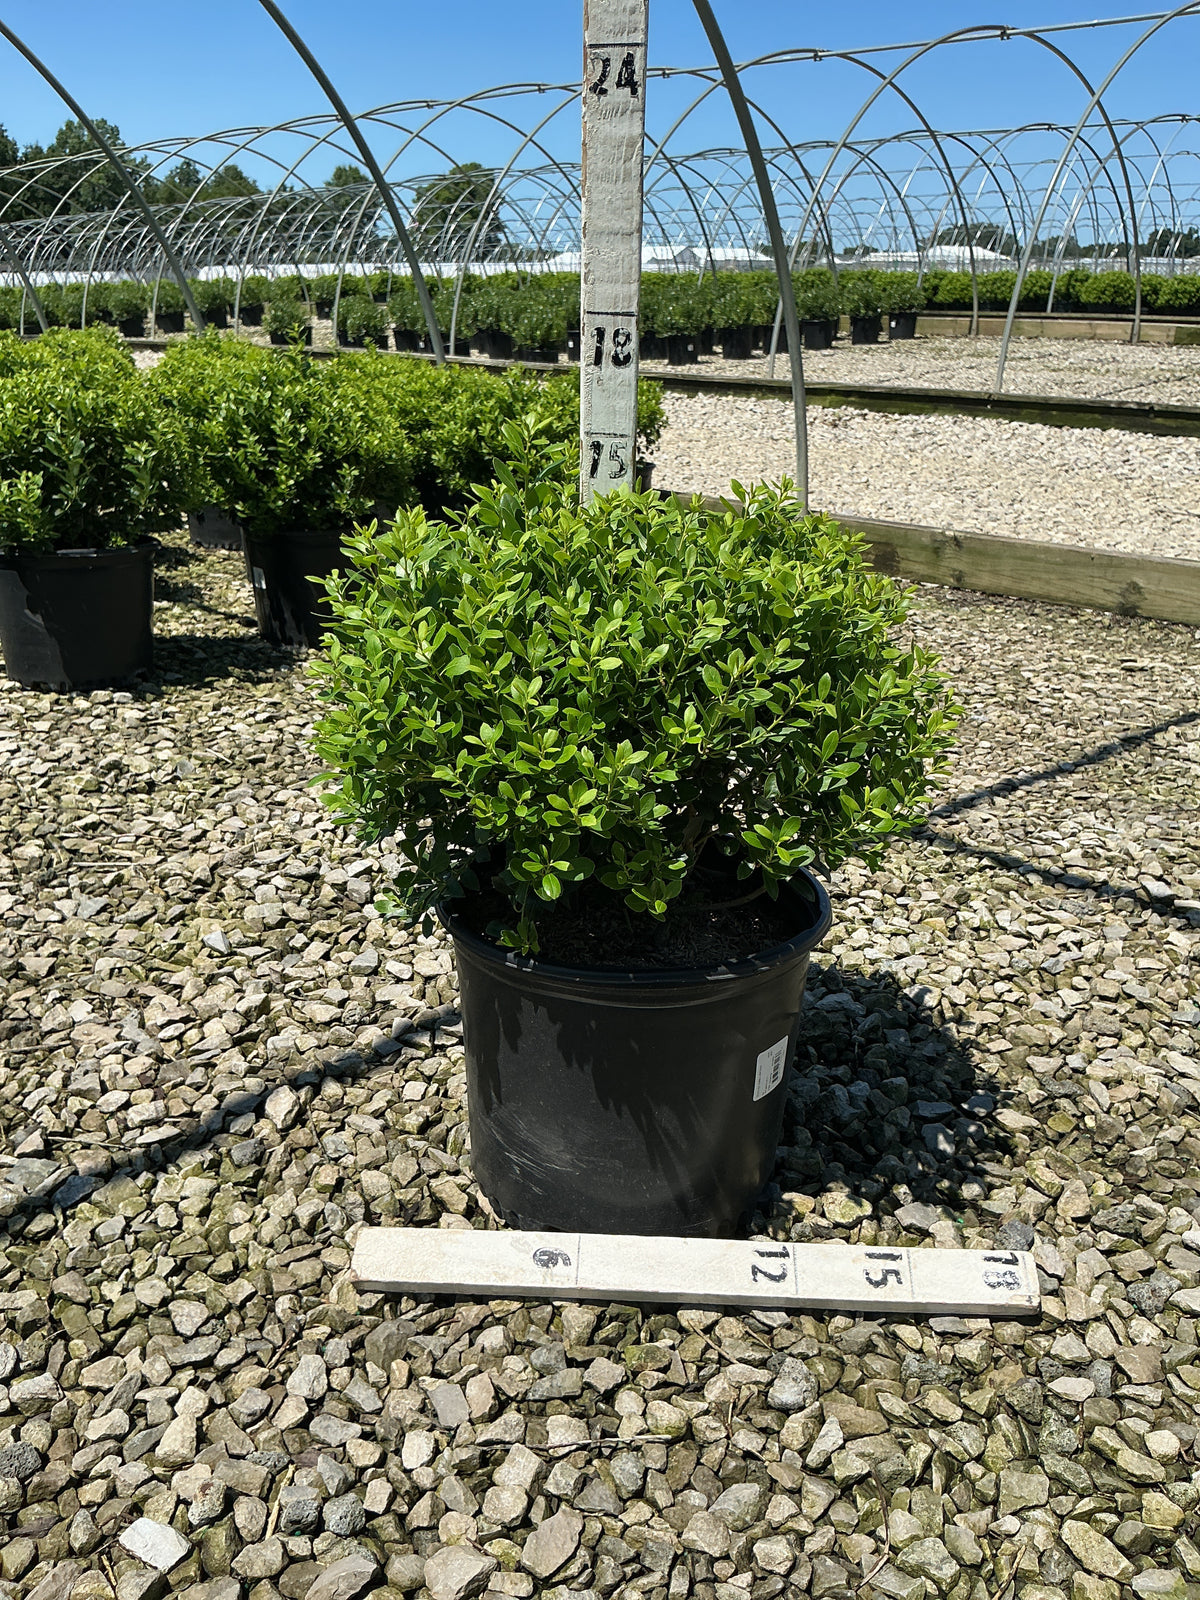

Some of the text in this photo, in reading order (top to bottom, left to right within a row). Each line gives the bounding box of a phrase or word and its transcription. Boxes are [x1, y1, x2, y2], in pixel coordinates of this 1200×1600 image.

[589, 51, 638, 96] 24
[591, 326, 633, 369] 18
[589, 440, 628, 479] 15
[751, 1245, 790, 1283] 12
[863, 1251, 903, 1289] 15
[982, 1251, 1022, 1291] 18
